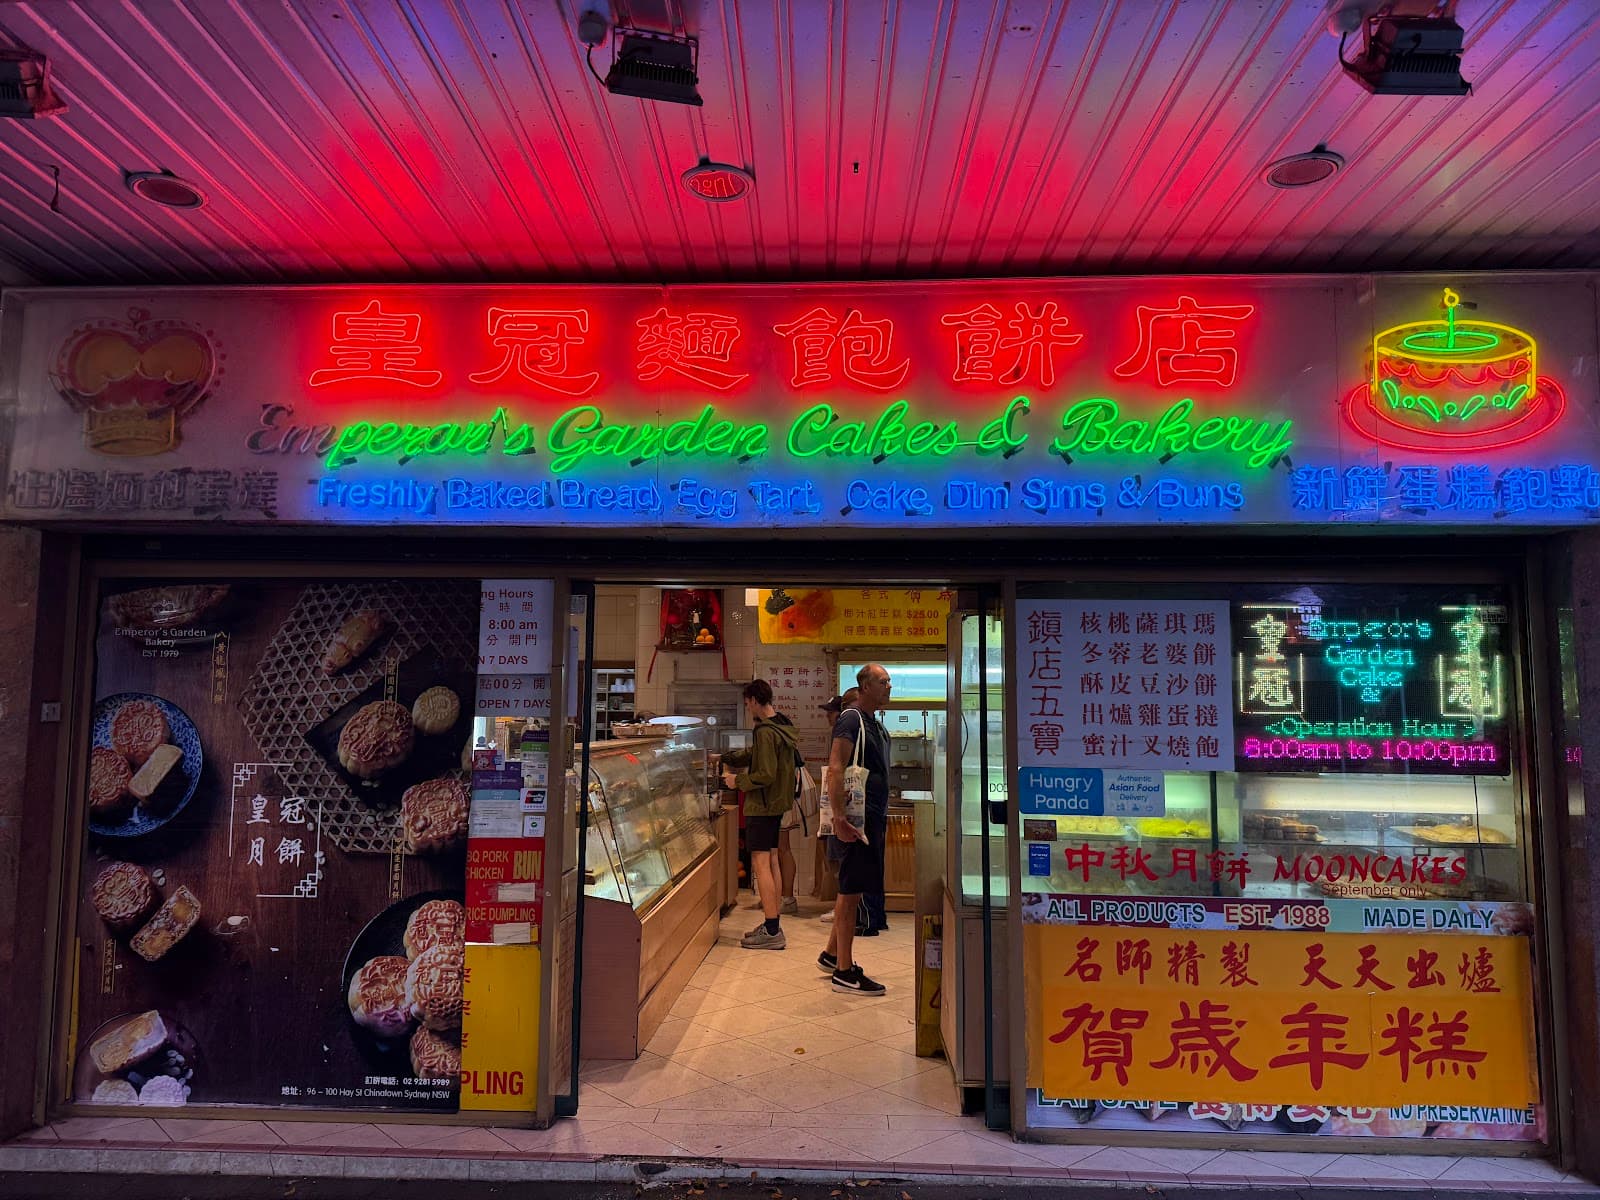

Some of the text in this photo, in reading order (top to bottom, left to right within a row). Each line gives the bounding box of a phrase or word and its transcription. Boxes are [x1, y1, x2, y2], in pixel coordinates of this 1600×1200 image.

[309, 296, 1255, 395] 皇冠麵飽餅店
[246, 404, 535, 470] Emperor's
[547, 403, 768, 473] Garden
[787, 399, 958, 457] Cakes
[1051, 398, 1294, 469] Bakery
[319, 478, 434, 512] Freshly
[447, 479, 547, 508] Baked
[679, 480, 738, 519] Egg
[947, 480, 1010, 511] Dim
[1023, 478, 1105, 511] Sims
[1119, 478, 1143, 509] &
[1154, 479, 1246, 510] Buns
[499, 588, 533, 599] Hours
[115, 628, 207, 638] Emperor's Garden
[488, 619, 538, 630] 8:00 am
[1080, 611, 1216, 636] 核桃薩琪瑪
[145, 638, 176, 648] Bakery
[1081, 641, 1217, 666] 冬蓉老婆餅
[489, 655, 496, 665] 7
[498, 655, 528, 665] DAYS
[1325, 643, 1416, 666] Garden
[1027, 609, 1064, 757] 鎮店五寶
[1080, 672, 1217, 697] 酥皮豆沙餅
[1337, 667, 1404, 688] Cake
[478, 699, 551, 709] OPEN 7 DAYS
[1359, 687, 1381, 704] &
[1348, 740, 1372, 760] to
[1382, 740, 1496, 767] 10:00pm
[1029, 772, 1093, 793] Hungry
[1109, 783, 1160, 793] Asian Food
[1116, 774, 1152, 782] Authentic
[1035, 794, 1089, 811] Panda
[1119, 793, 1149, 802] Delivery
[245, 794, 306, 825] 皇冠
[247, 836, 306, 868] 月餅
[482, 850, 510, 863] PORK
[512, 850, 542, 880] BUN
[1065, 843, 1252, 890] 中秋月餅
[1273, 853, 1467, 885] MOONCAKES
[1321, 881, 1427, 899] September only
[466, 907, 536, 921] RICE DUMPLING
[1046, 901, 1088, 921] ALL
[1091, 902, 1205, 924] PRODUCTS
[1225, 905, 1274, 926] EST.
[1278, 906, 1330, 927] 1988
[1363, 908, 1426, 928] MADE
[1064, 936, 1502, 994] 名師精製 天天出爐
[413, 1078, 431, 1086] 9281
[432, 1079, 450, 1087] 5989
[306, 1088, 317, 1096] 96
[325, 1088, 338, 1096] 100
[339, 1088, 354, 1098] Hay
[364, 1088, 403, 1098] Chinatown
[403, 1089, 431, 1100] Sydney
[432, 1090, 450, 1099] NSW
[1417, 1105, 1535, 1126] PRESERVATIVE
